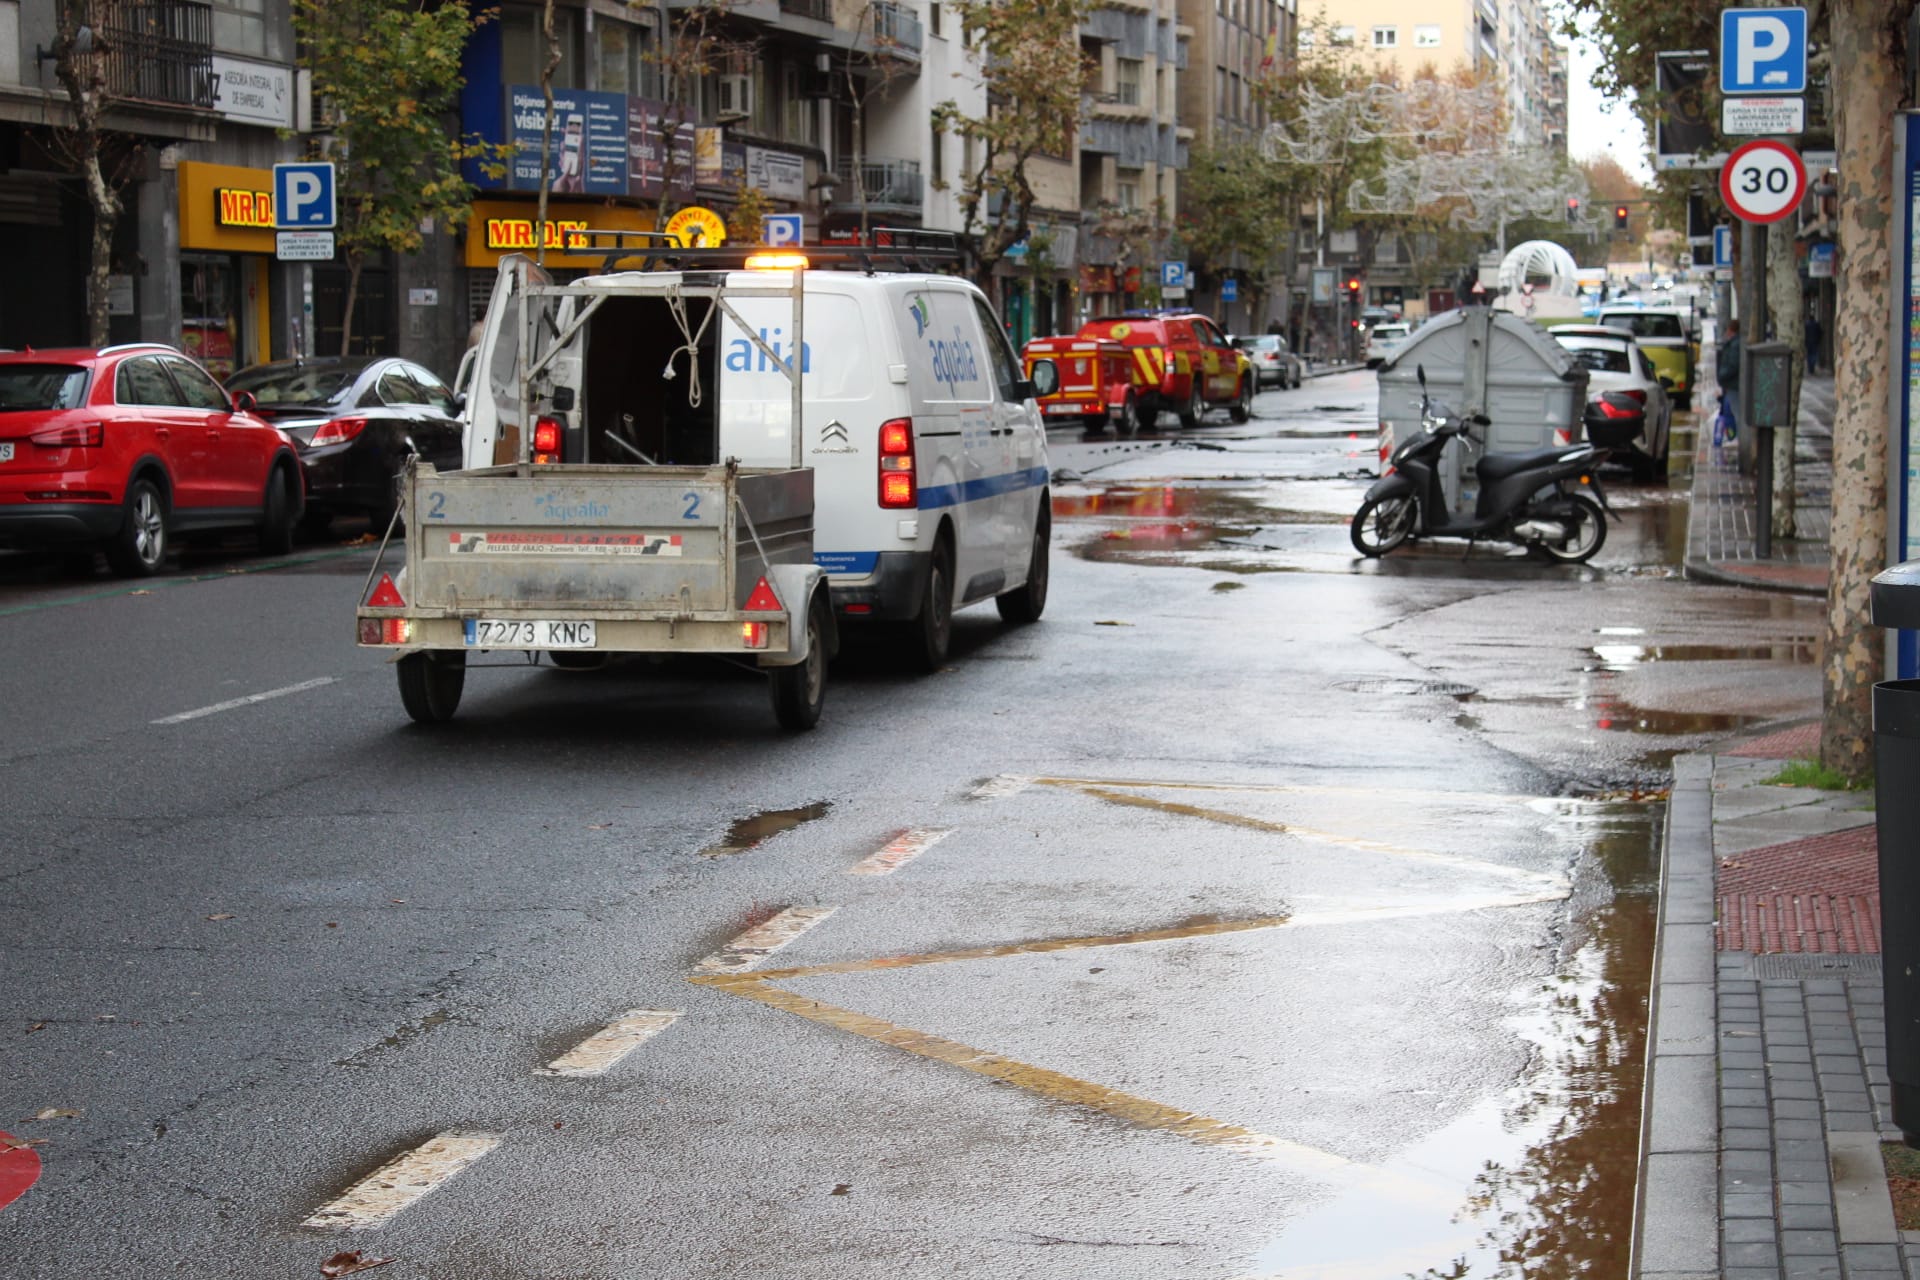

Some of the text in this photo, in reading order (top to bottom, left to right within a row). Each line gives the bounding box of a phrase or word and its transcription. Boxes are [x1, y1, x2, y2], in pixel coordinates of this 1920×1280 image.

[1736, 16, 1790, 85] P
[1741, 167, 1789, 194] 30
[221, 189, 253, 225] MR
[286, 172, 321, 221] P
[488, 219, 532, 249] MR
[769, 220, 794, 248] P
[1165, 264, 1180, 284] P
[928, 325, 978, 399] aqualia
[428, 491, 700, 521] 2 aqualia 2
[479, 622, 590, 643] 7273 KNC
